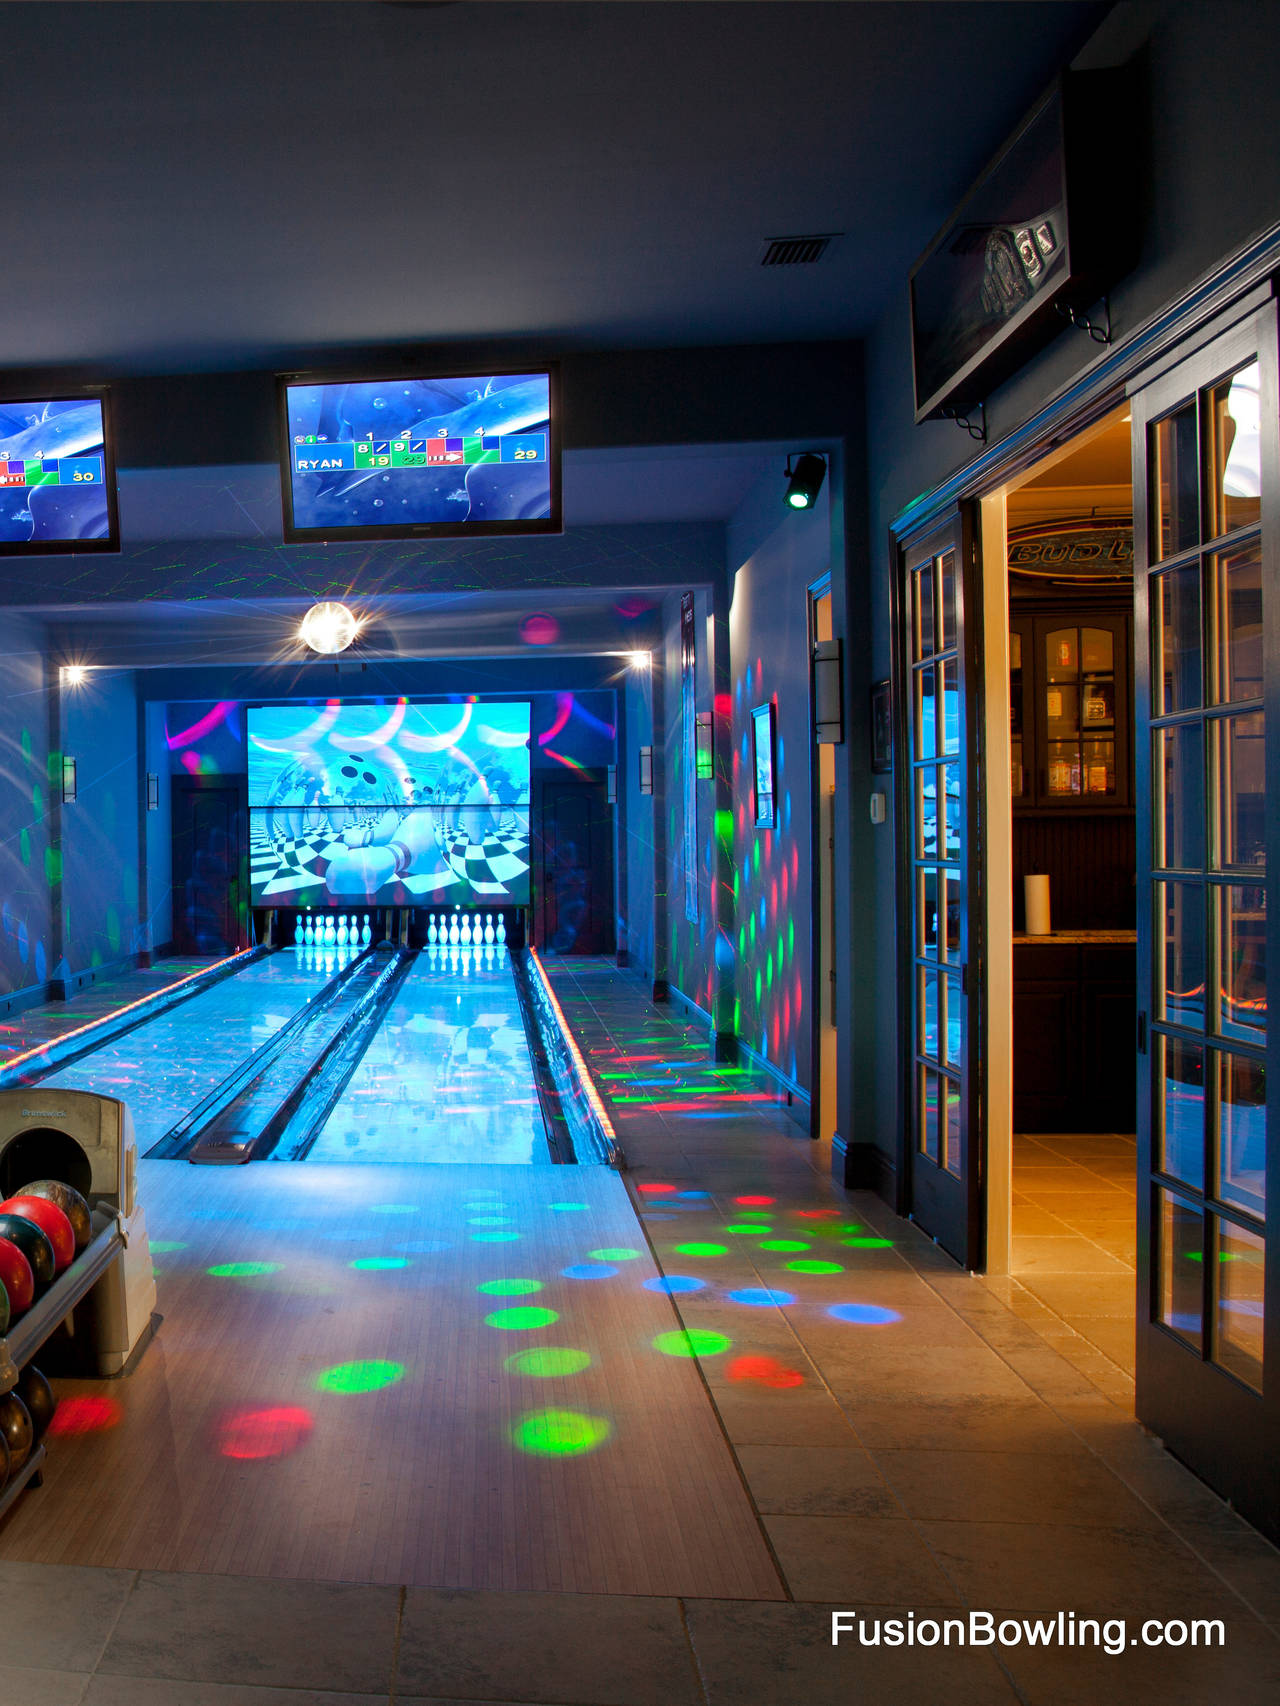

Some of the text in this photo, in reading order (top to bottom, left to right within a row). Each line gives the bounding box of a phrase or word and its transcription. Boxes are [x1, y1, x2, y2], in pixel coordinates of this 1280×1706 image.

[298, 458, 343, 470] RYAN
[369, 457, 389, 466] 19
[514, 450, 537, 460] 29
[72, 472, 94, 482] 30
[1008, 543, 1103, 565] BUD
